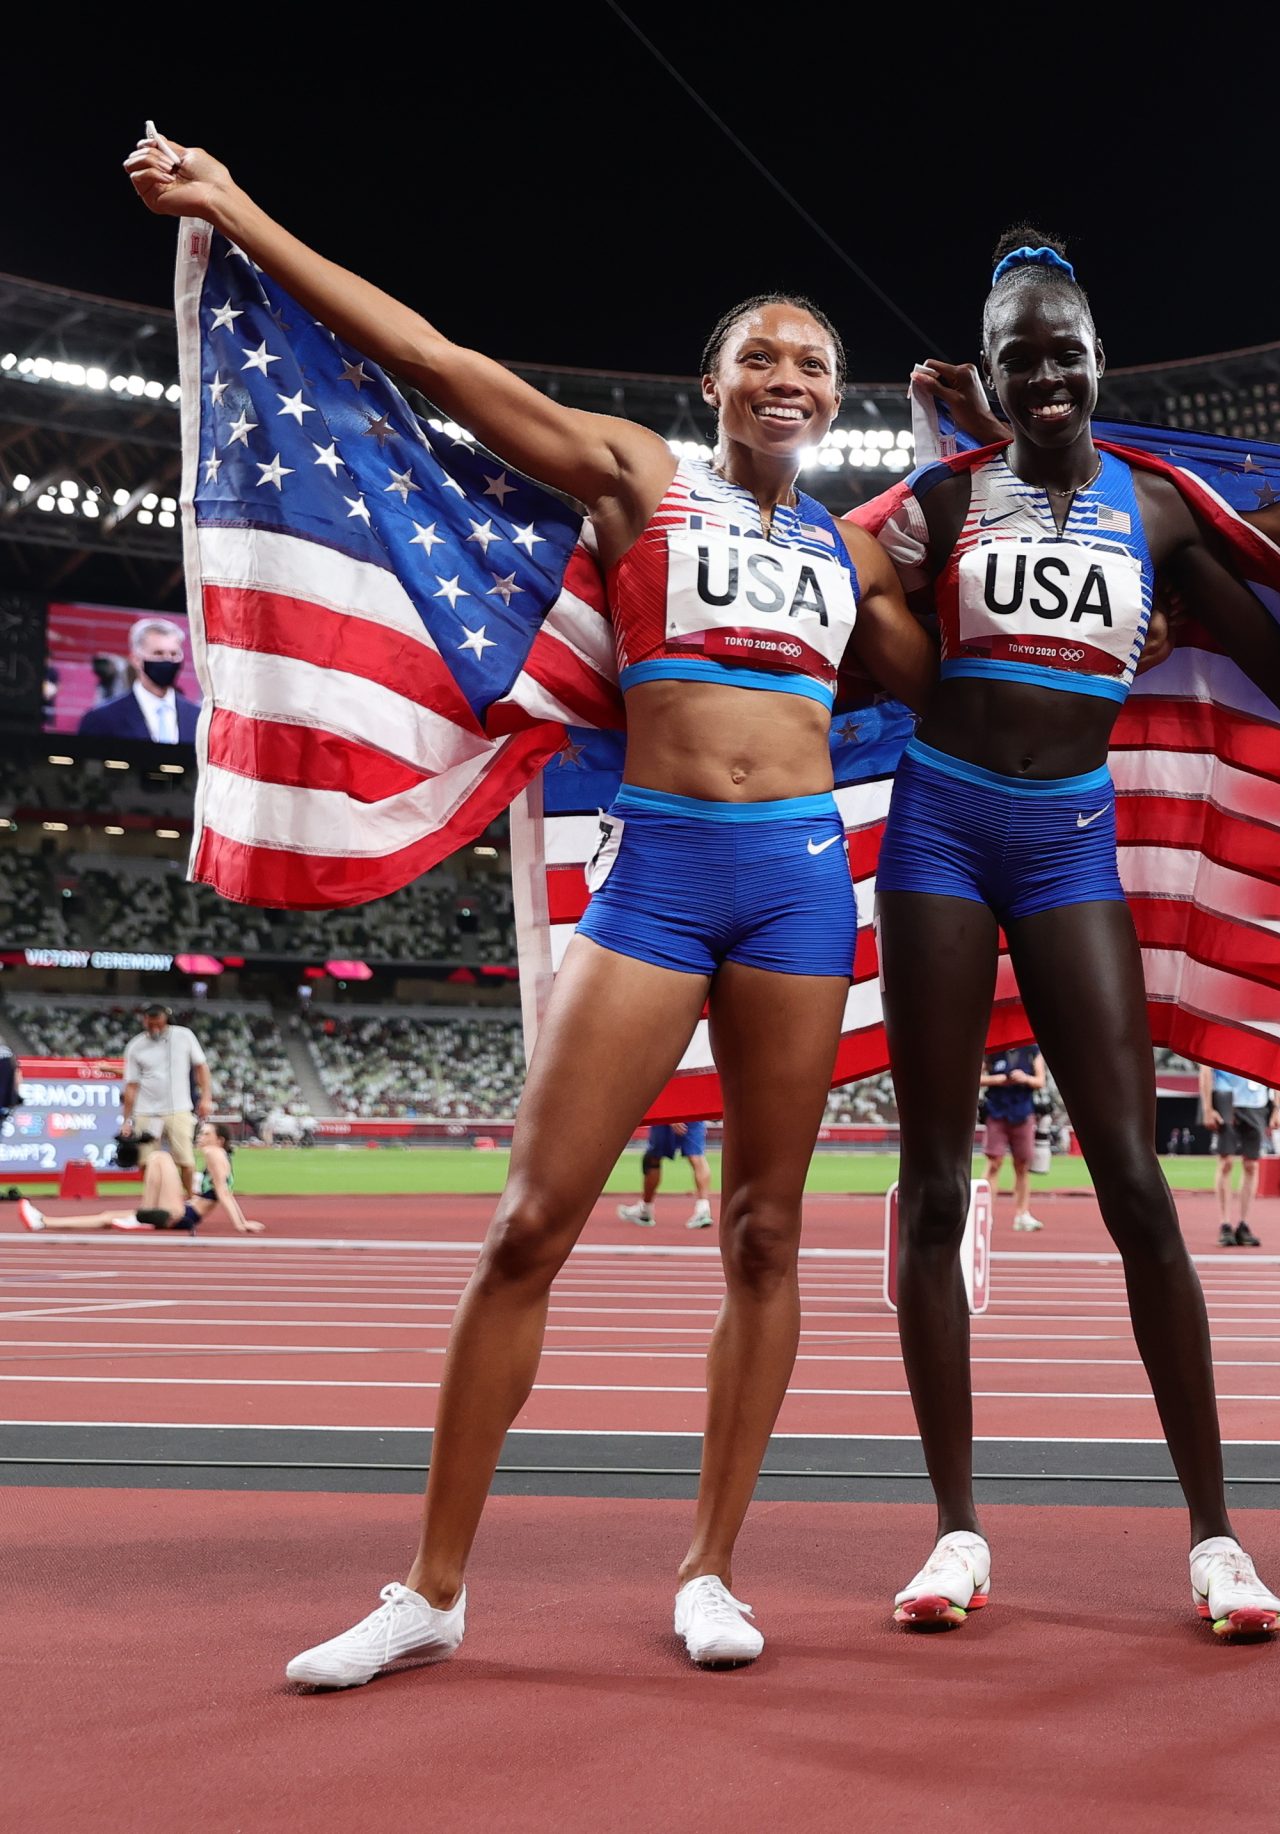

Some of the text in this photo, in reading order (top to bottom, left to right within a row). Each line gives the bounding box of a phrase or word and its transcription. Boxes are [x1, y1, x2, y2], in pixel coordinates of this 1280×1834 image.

[697, 545, 829, 628] USA
[984, 553, 1113, 628] USA
[724, 636, 777, 651] TOKYO 2020
[1008, 643, 1057, 657] TOKYO 2020
[25, 948, 174, 972] VICTORY CEREMONY
[51, 1113, 97, 1130] RANK
